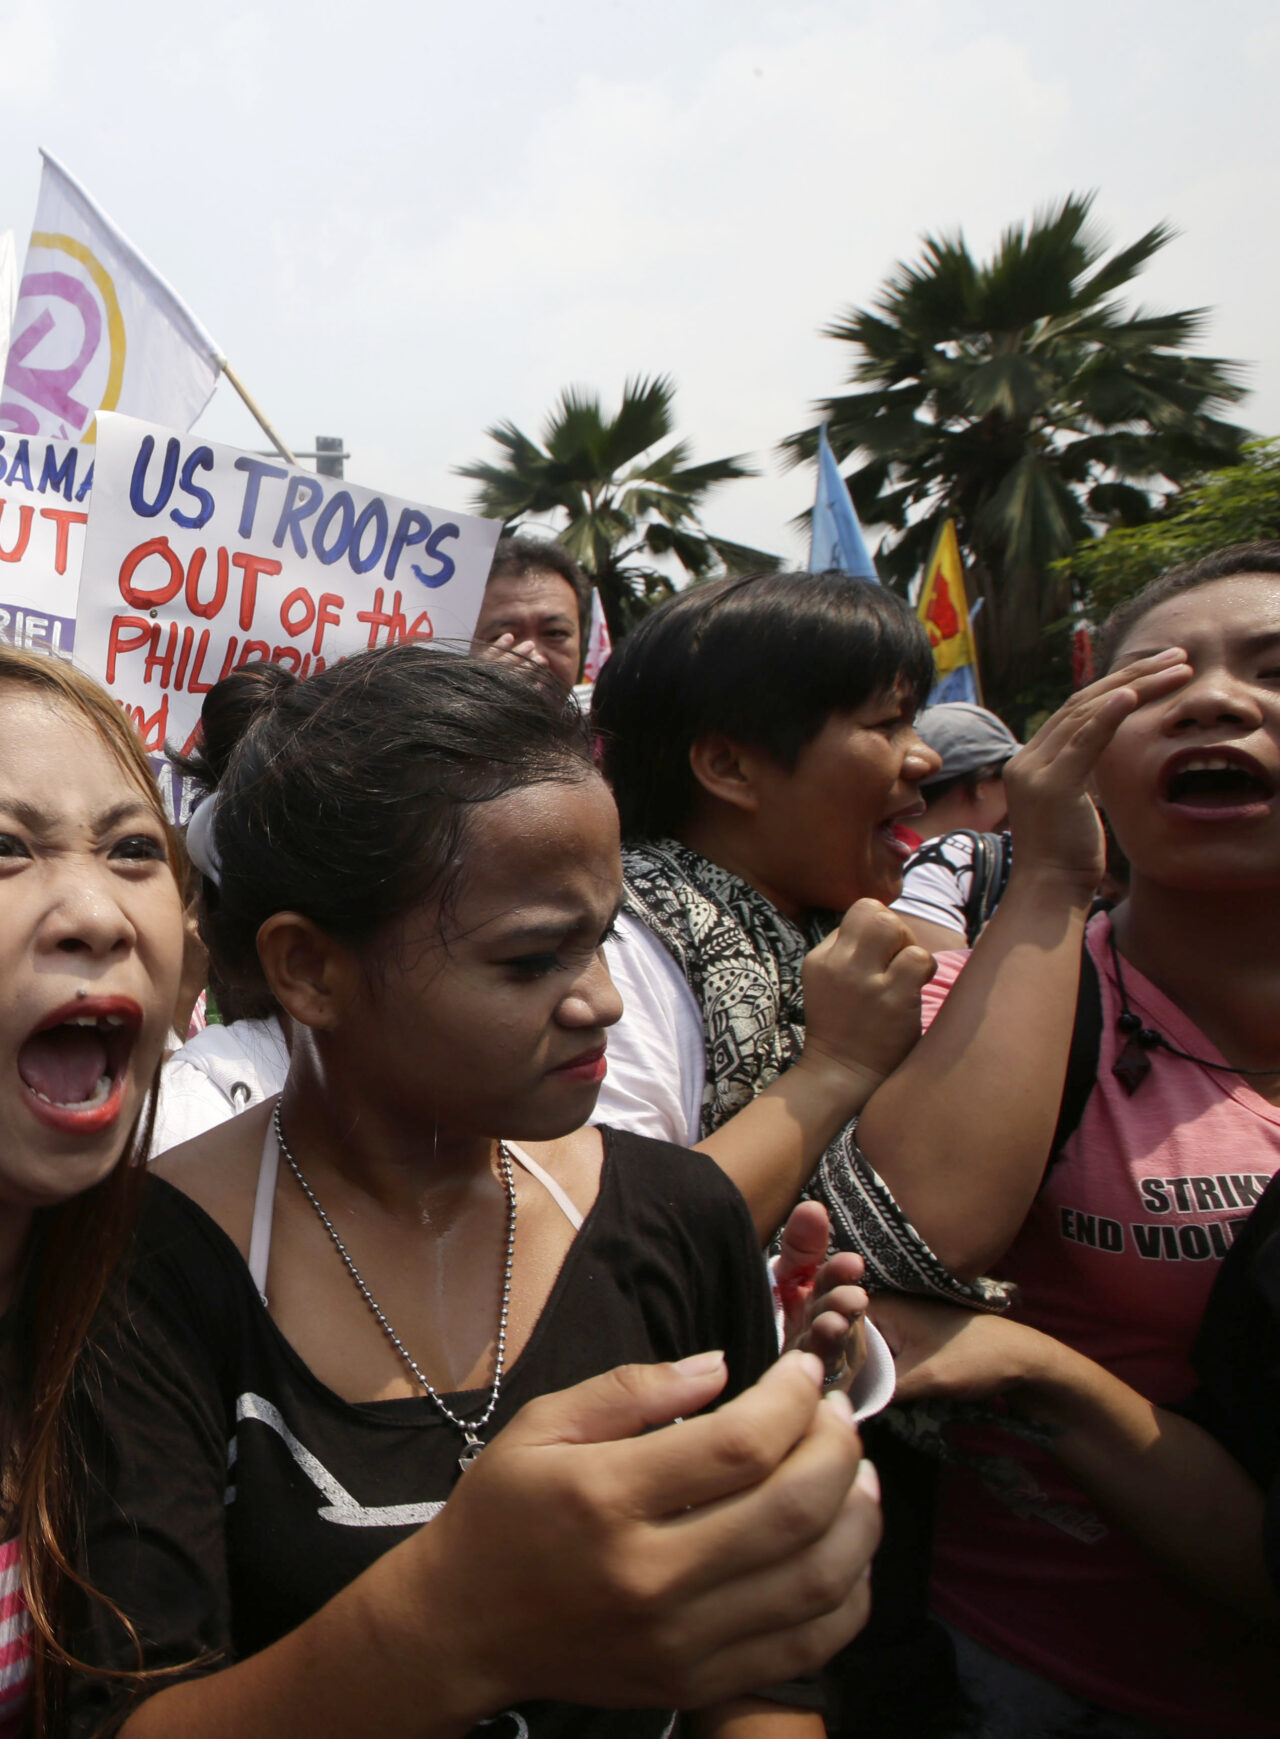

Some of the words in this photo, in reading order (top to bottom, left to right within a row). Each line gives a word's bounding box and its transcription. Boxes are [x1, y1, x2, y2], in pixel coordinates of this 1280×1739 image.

[129, 434, 214, 529] US
[234, 456, 461, 588] TROOPS
[120, 536, 282, 631] OUT
[118, 694, 168, 753] nd
[1059, 1205, 1124, 1253] END
